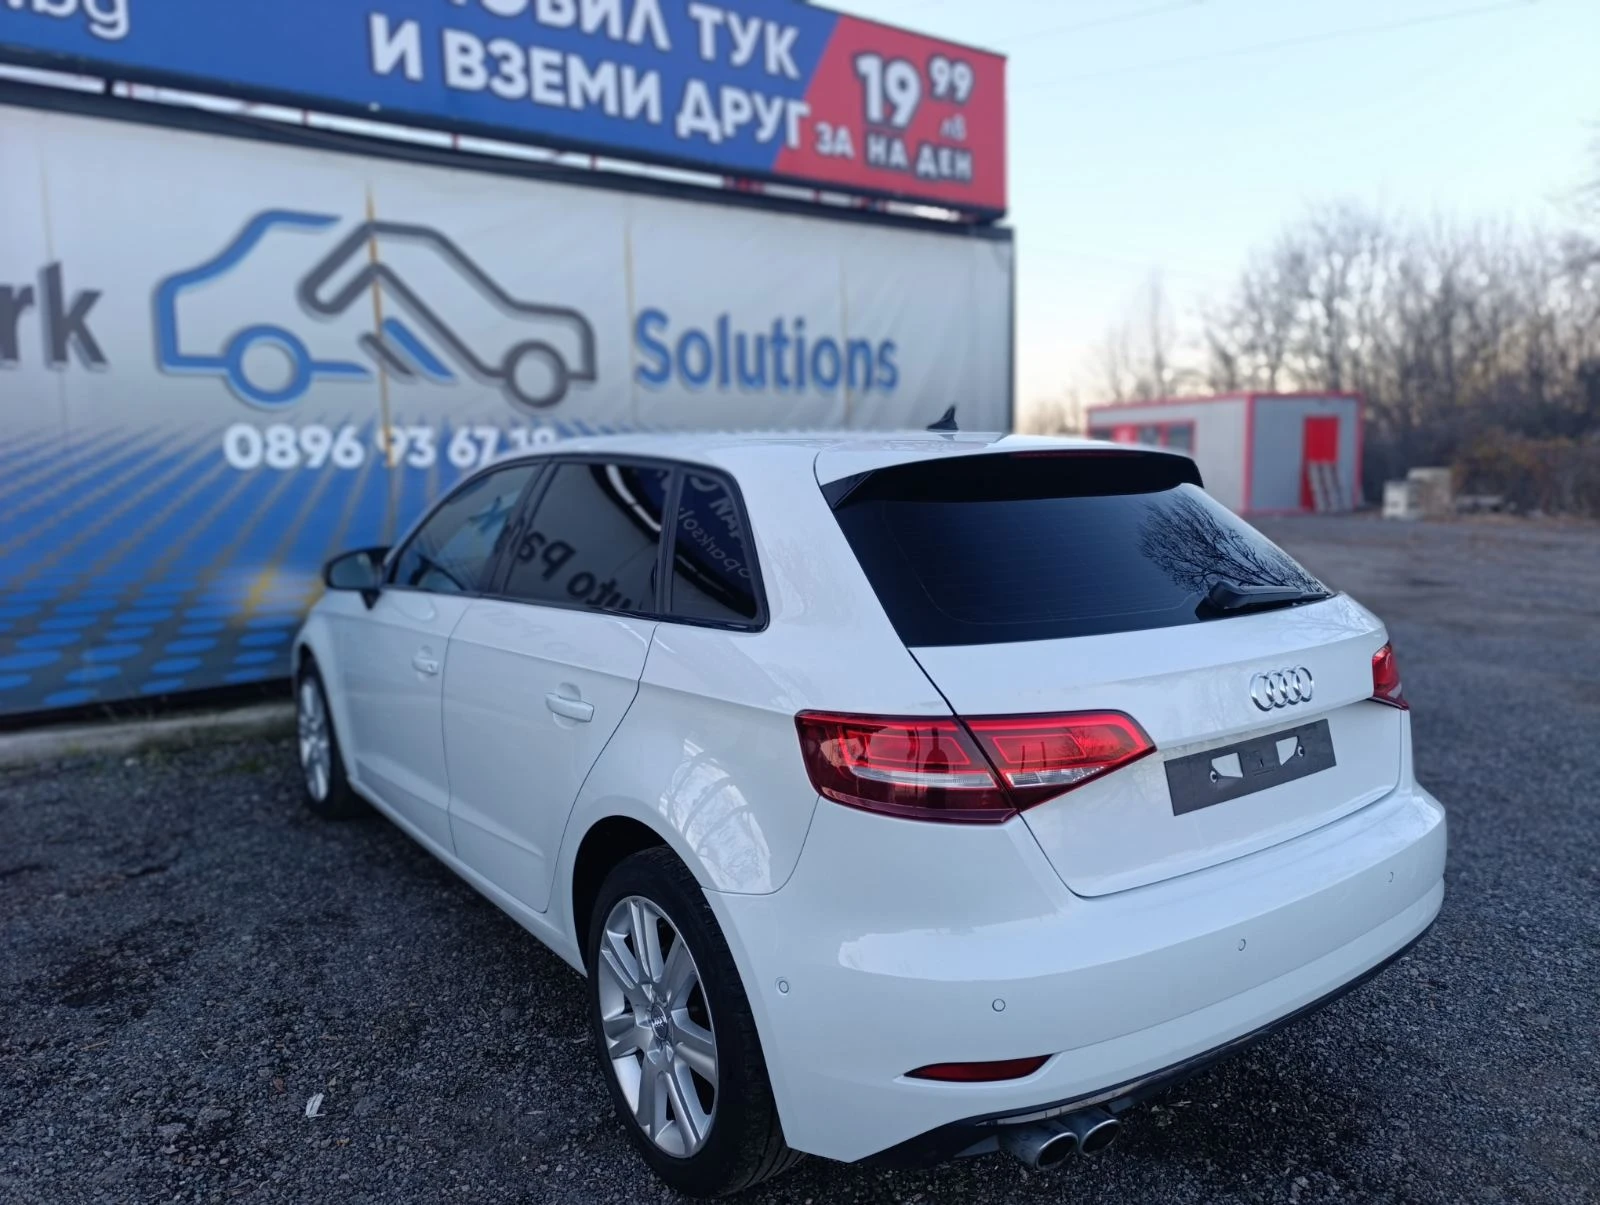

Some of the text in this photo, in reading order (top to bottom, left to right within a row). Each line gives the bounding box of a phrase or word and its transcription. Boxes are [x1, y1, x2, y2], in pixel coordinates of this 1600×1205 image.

[689, 2, 800, 79] ТУК
[370, 12, 810, 149] И ВЗЕМИ ДРУГ
[855, 53, 973, 128] 19 99
[815, 121, 972, 181] ЗА НА ДЕН
[634, 307, 898, 391] Solutions
[223, 422, 365, 469] 0896
[376, 425, 436, 468] 93
